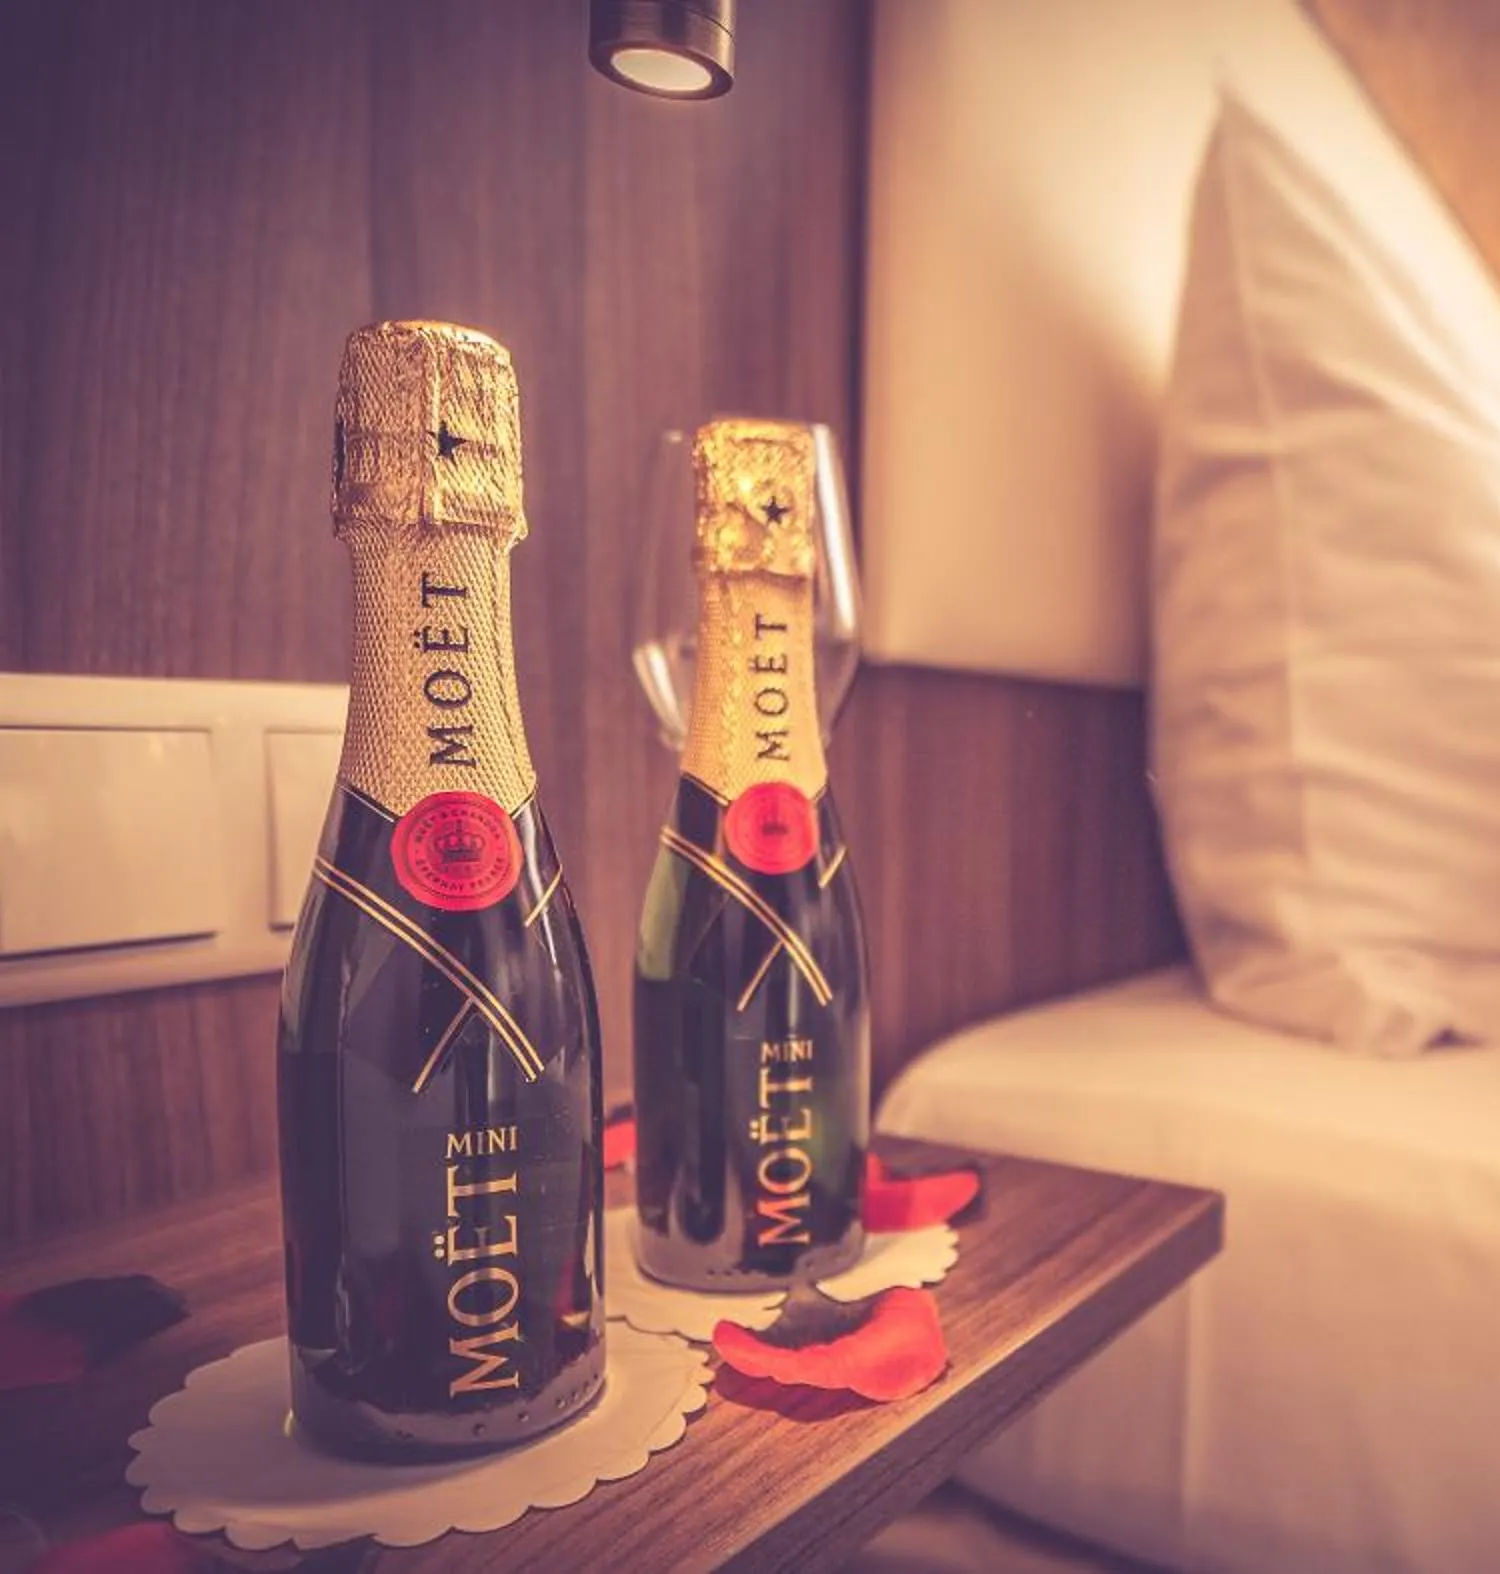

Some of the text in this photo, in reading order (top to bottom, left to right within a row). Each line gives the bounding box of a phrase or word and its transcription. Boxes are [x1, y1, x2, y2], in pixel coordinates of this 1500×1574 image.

[413, 570, 478, 769] MOËT
[749, 612, 791, 762] MOËT
[761, 1038, 813, 1063] MINI
[444, 1126, 518, 1160] MINI
[749, 1066, 813, 1247] MOËT
[433, 1164, 520, 1399] MOËT
